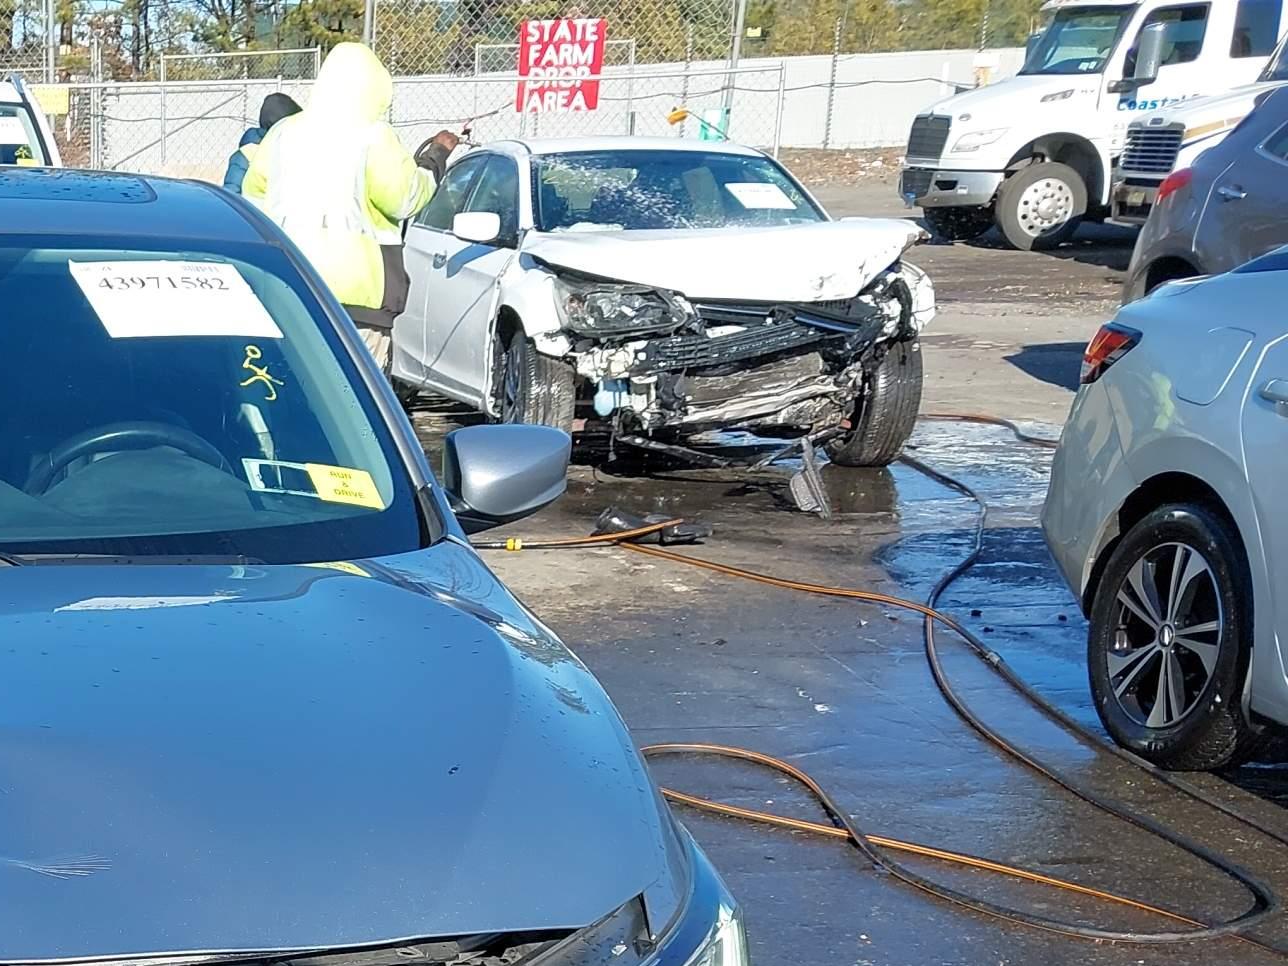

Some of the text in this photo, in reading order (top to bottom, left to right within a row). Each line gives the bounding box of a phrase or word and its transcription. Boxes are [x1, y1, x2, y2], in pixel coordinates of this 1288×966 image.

[526, 18, 600, 42] STATE
[529, 42, 595, 67] FARM
[525, 66, 591, 88] DROP
[525, 90, 587, 113] AREA
[98, 276, 230, 291] 43971582
[329, 471, 352, 479] RUN
[334, 488, 365, 499] DRIVE
